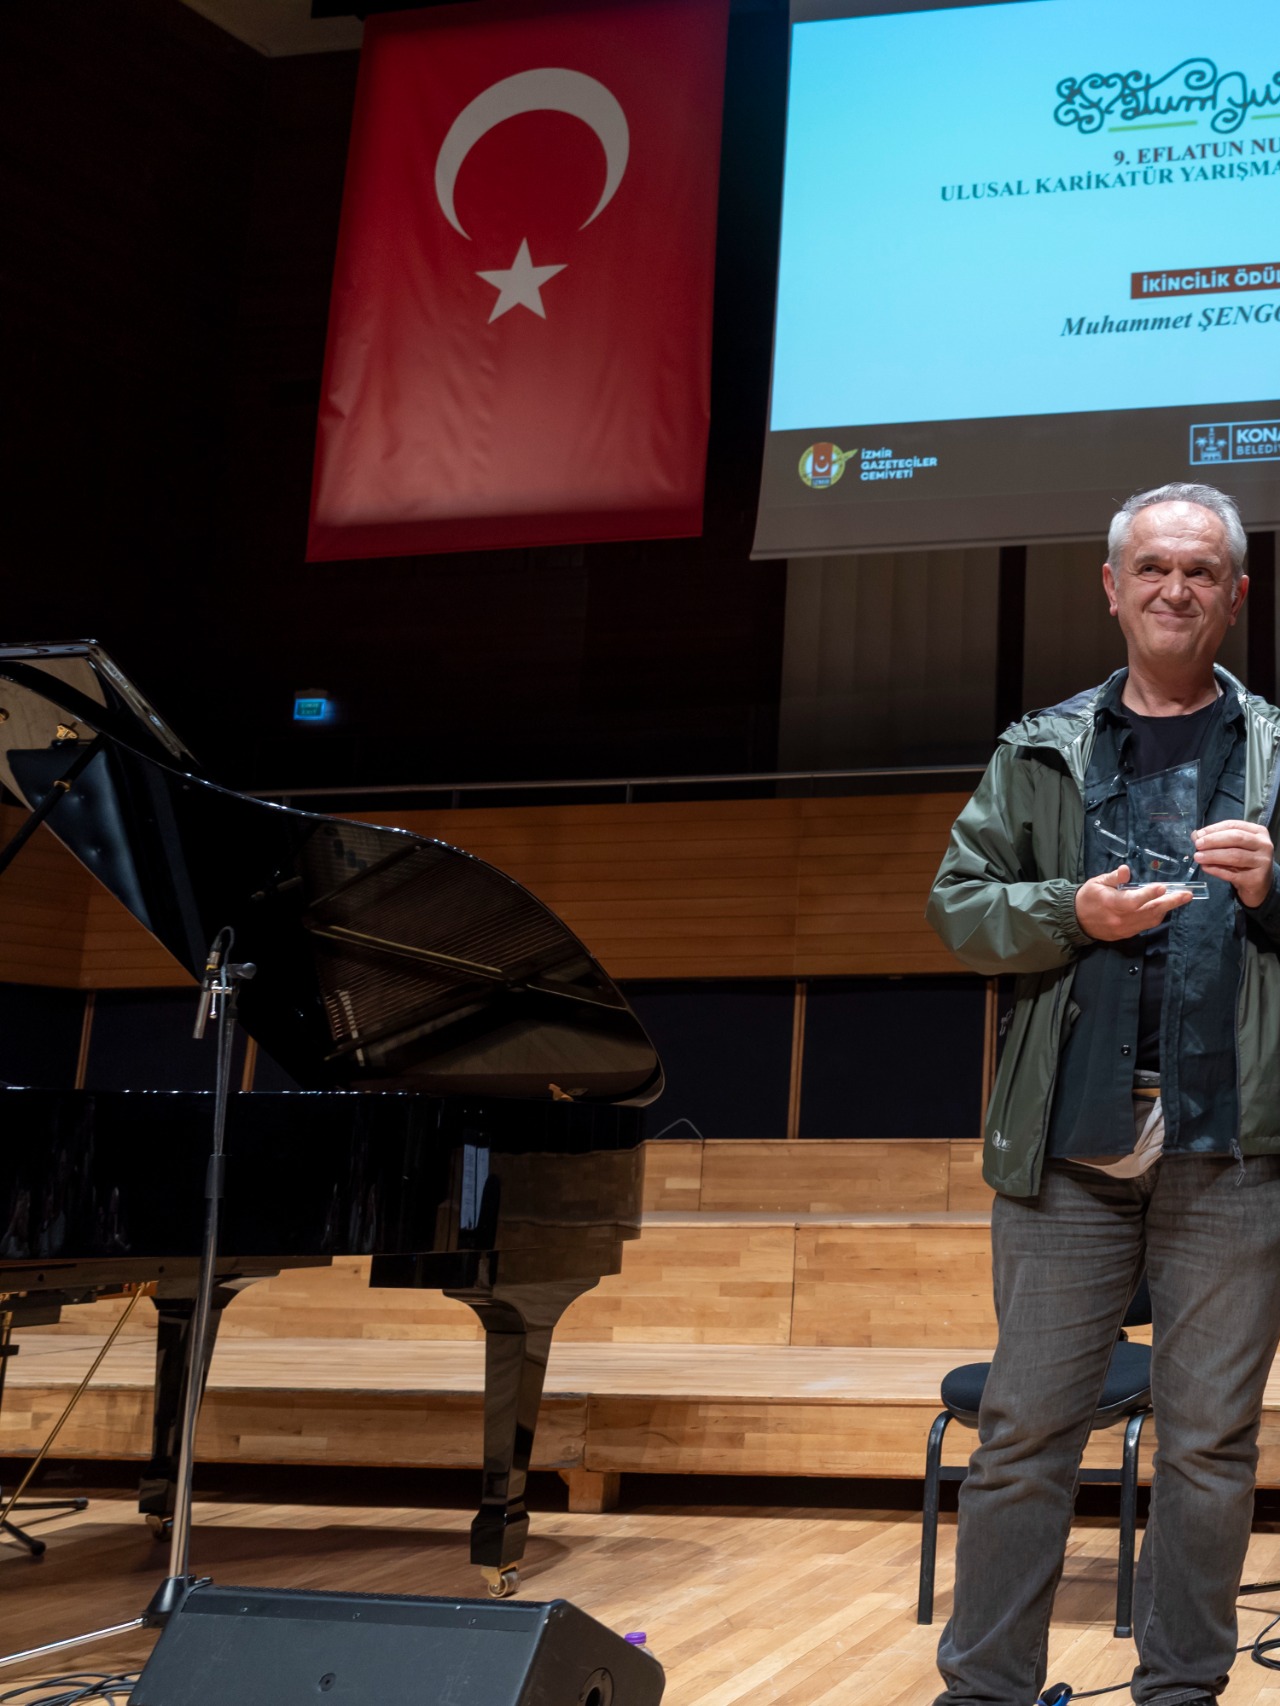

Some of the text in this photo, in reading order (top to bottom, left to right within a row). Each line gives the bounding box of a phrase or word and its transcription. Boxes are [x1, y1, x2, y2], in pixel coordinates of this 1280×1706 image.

[1114, 150, 1131, 167] 9.
[1138, 140, 1244, 163] EFLATUN
[940, 180, 1030, 202] ULUSAL
[1036, 166, 1173, 194] KARİKATÜR
[1142, 273, 1230, 293] İKİNCİLİK
[1060, 312, 1192, 337] Muhammet
[860, 456, 938, 470] GAZETECİLER
[861, 448, 893, 459] İZMİR
[860, 469, 913, 481] CEMİYETİ
